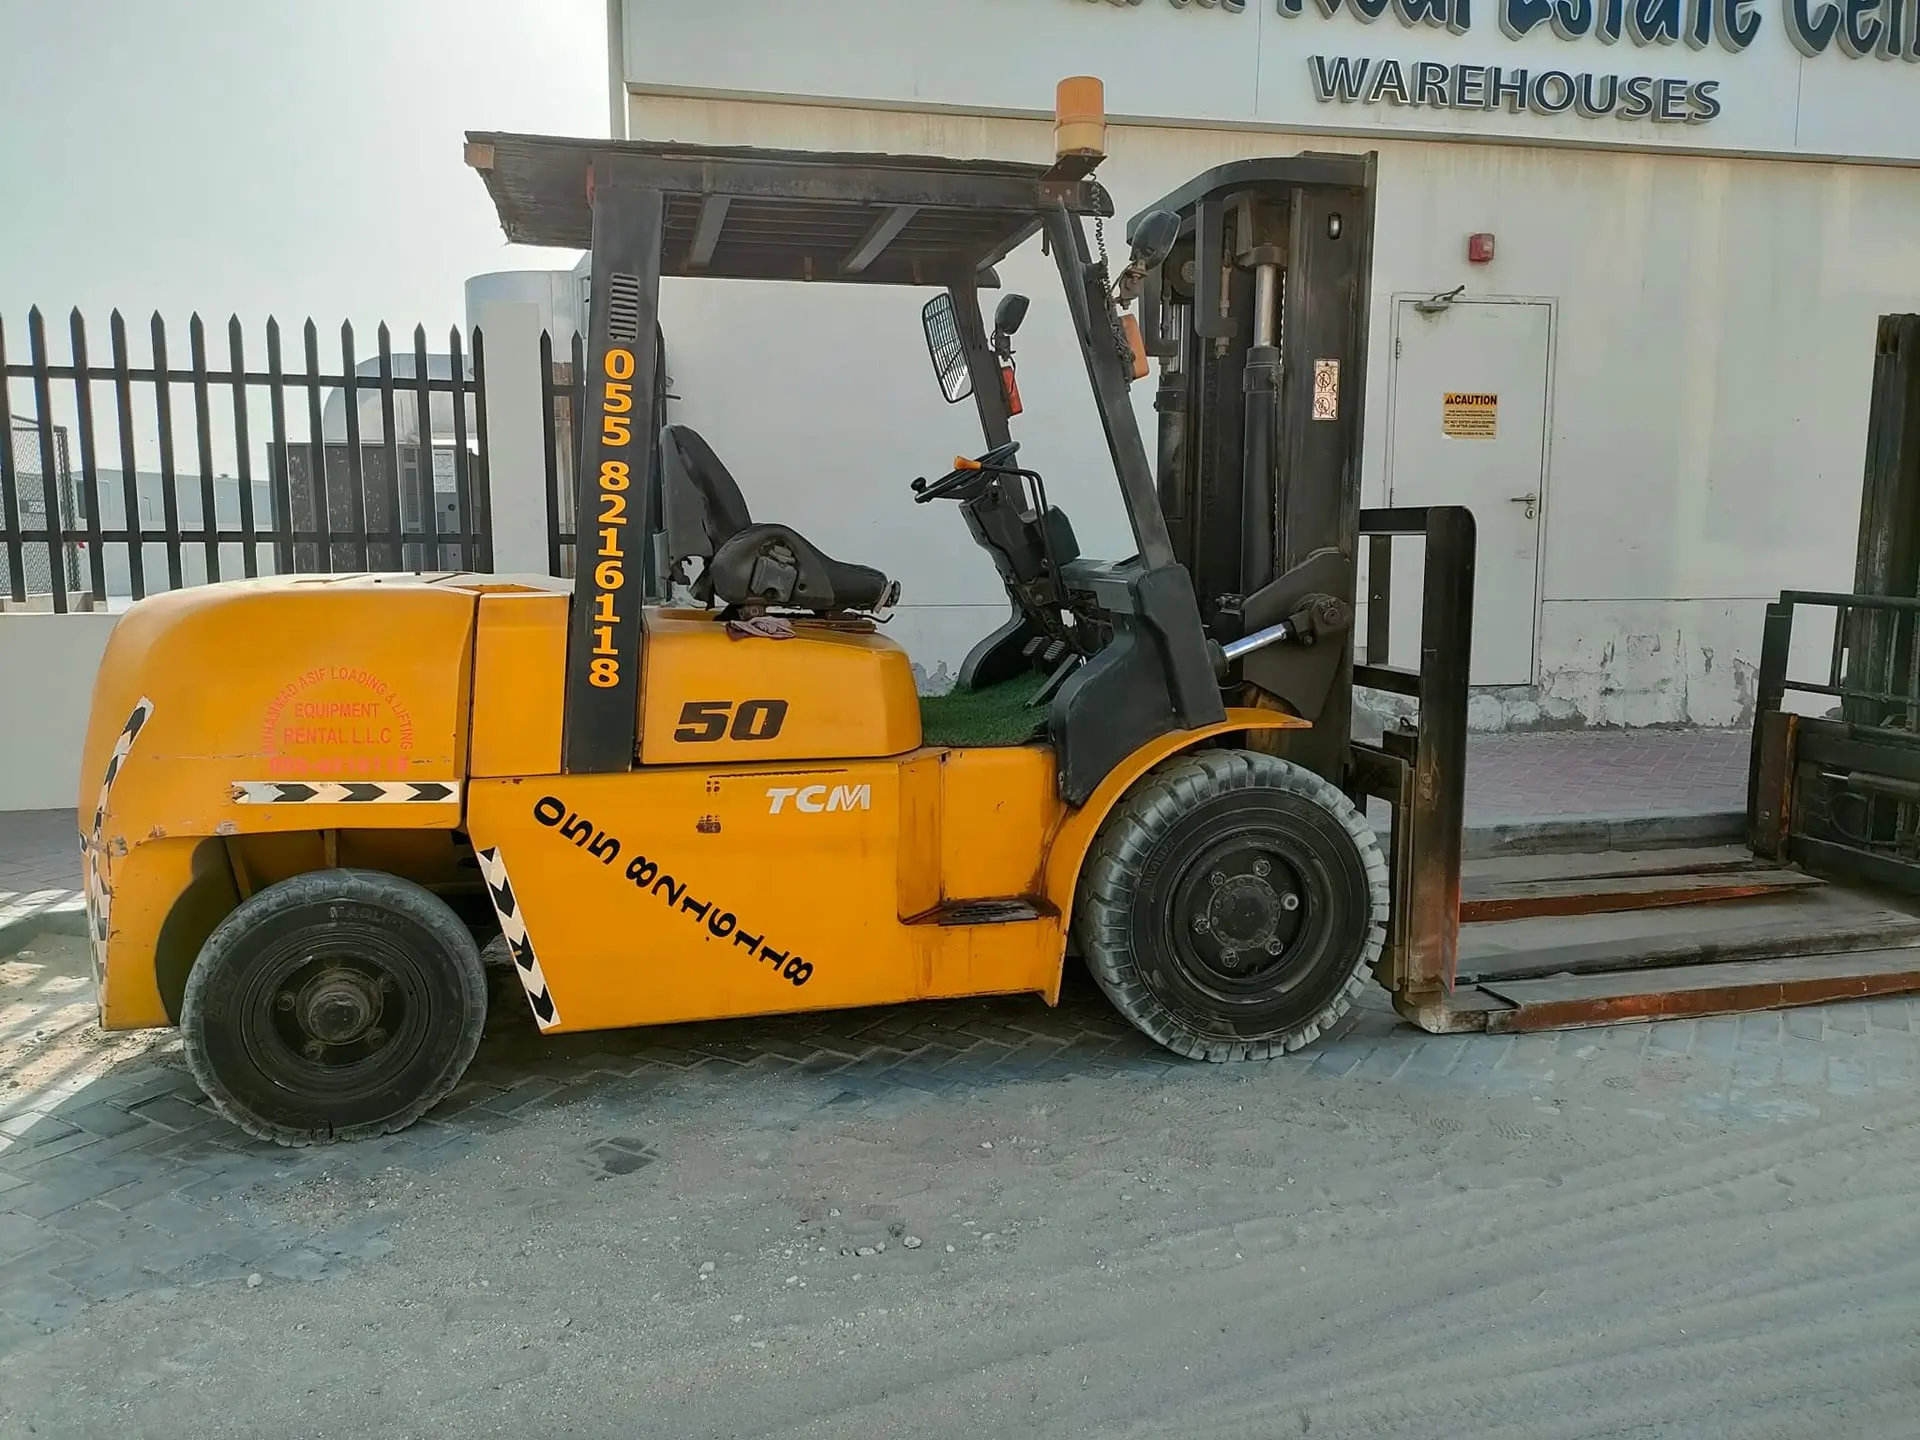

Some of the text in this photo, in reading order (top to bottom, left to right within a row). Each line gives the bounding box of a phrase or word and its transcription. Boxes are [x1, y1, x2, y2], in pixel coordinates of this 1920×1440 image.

[1308, 54, 1721, 123] WAREHOUSES
[1454, 394, 1498, 405] CAUTION
[588, 348, 636, 688] 055 8216118
[294, 702, 381, 719] EQUIPMENT
[299, 667, 326, 689] ASIF
[331, 666, 387, 694] LOADING
[385, 692, 397, 704] &
[391, 701, 413, 751] LIFTING
[673, 699, 789, 743] 50
[284, 727, 348, 745] RENTAL
[765, 783, 871, 815] TCM
[533, 795, 814, 987] 055 8216118
